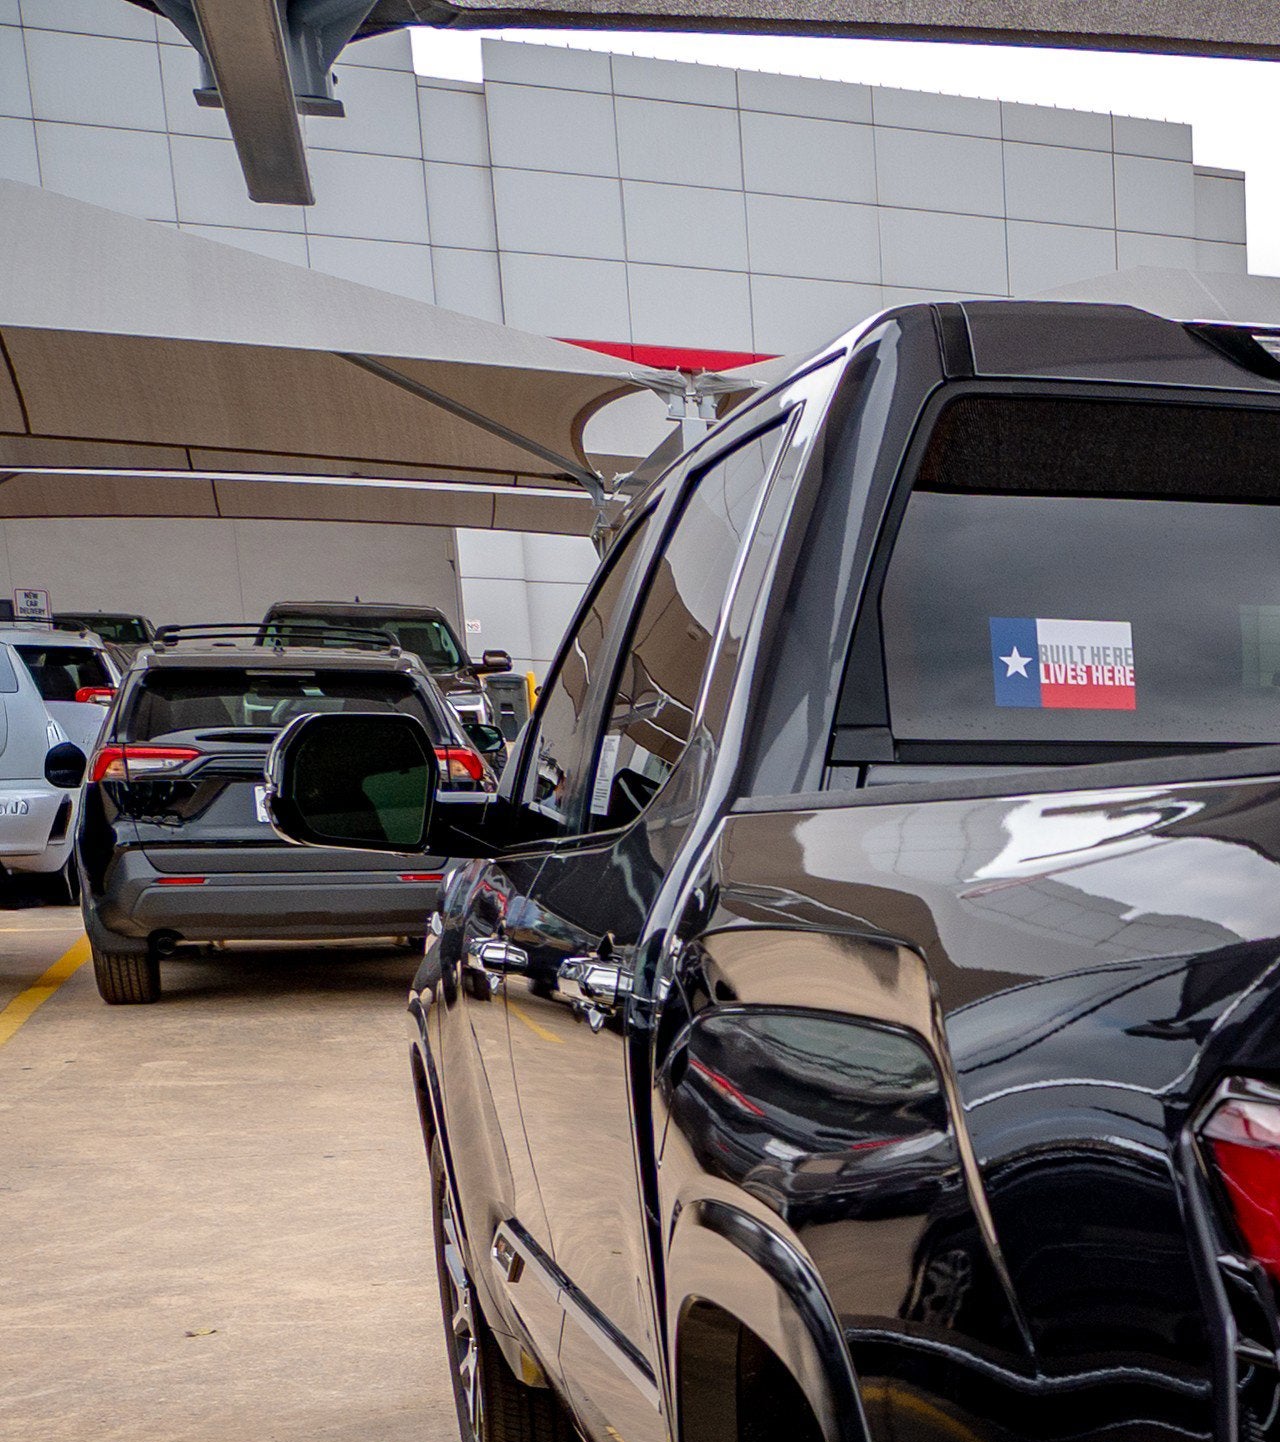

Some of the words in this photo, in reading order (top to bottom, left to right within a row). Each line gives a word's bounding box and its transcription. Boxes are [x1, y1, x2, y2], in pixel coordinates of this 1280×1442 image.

[1038, 644, 1087, 666] BUILT
[1090, 646, 1134, 667] HERE
[1039, 664, 1088, 685] LIVES
[1092, 665, 1136, 687] HERE
